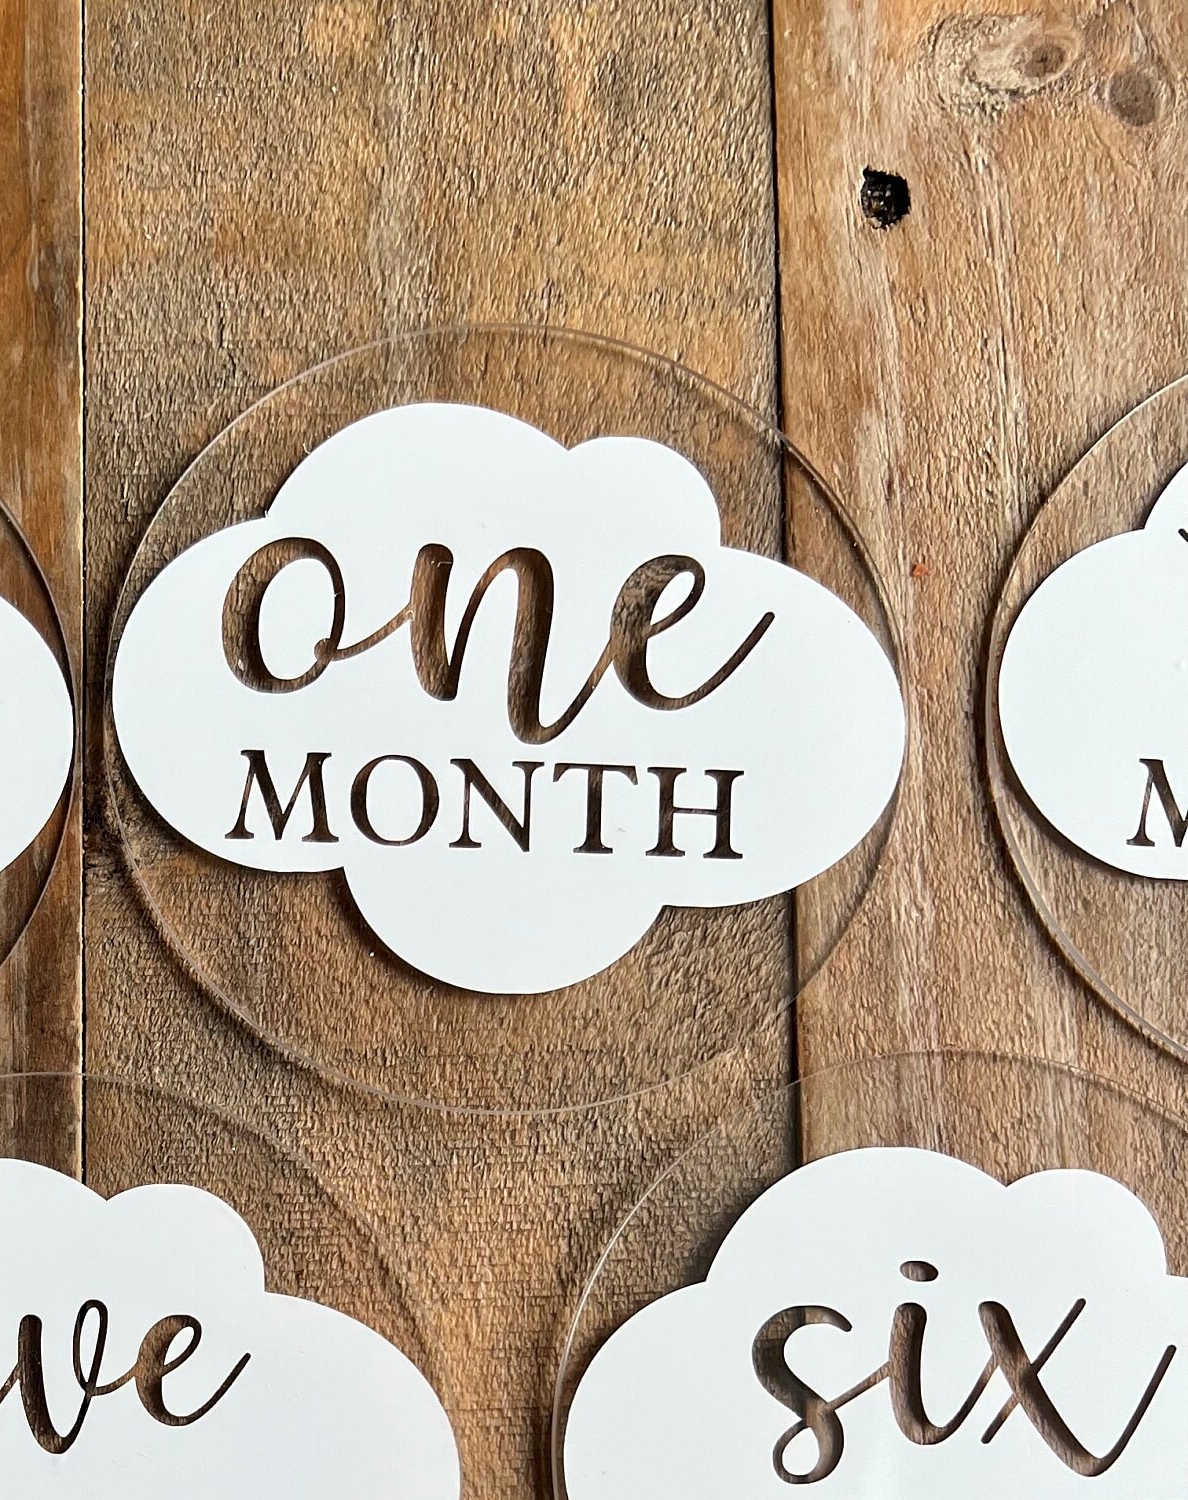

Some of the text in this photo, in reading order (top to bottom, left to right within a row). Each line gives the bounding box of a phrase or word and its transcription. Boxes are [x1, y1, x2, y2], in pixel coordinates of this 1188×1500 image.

[222, 537, 775, 744] one
[225, 750, 744, 859] MONTH
[752, 1261, 1176, 1484] six
